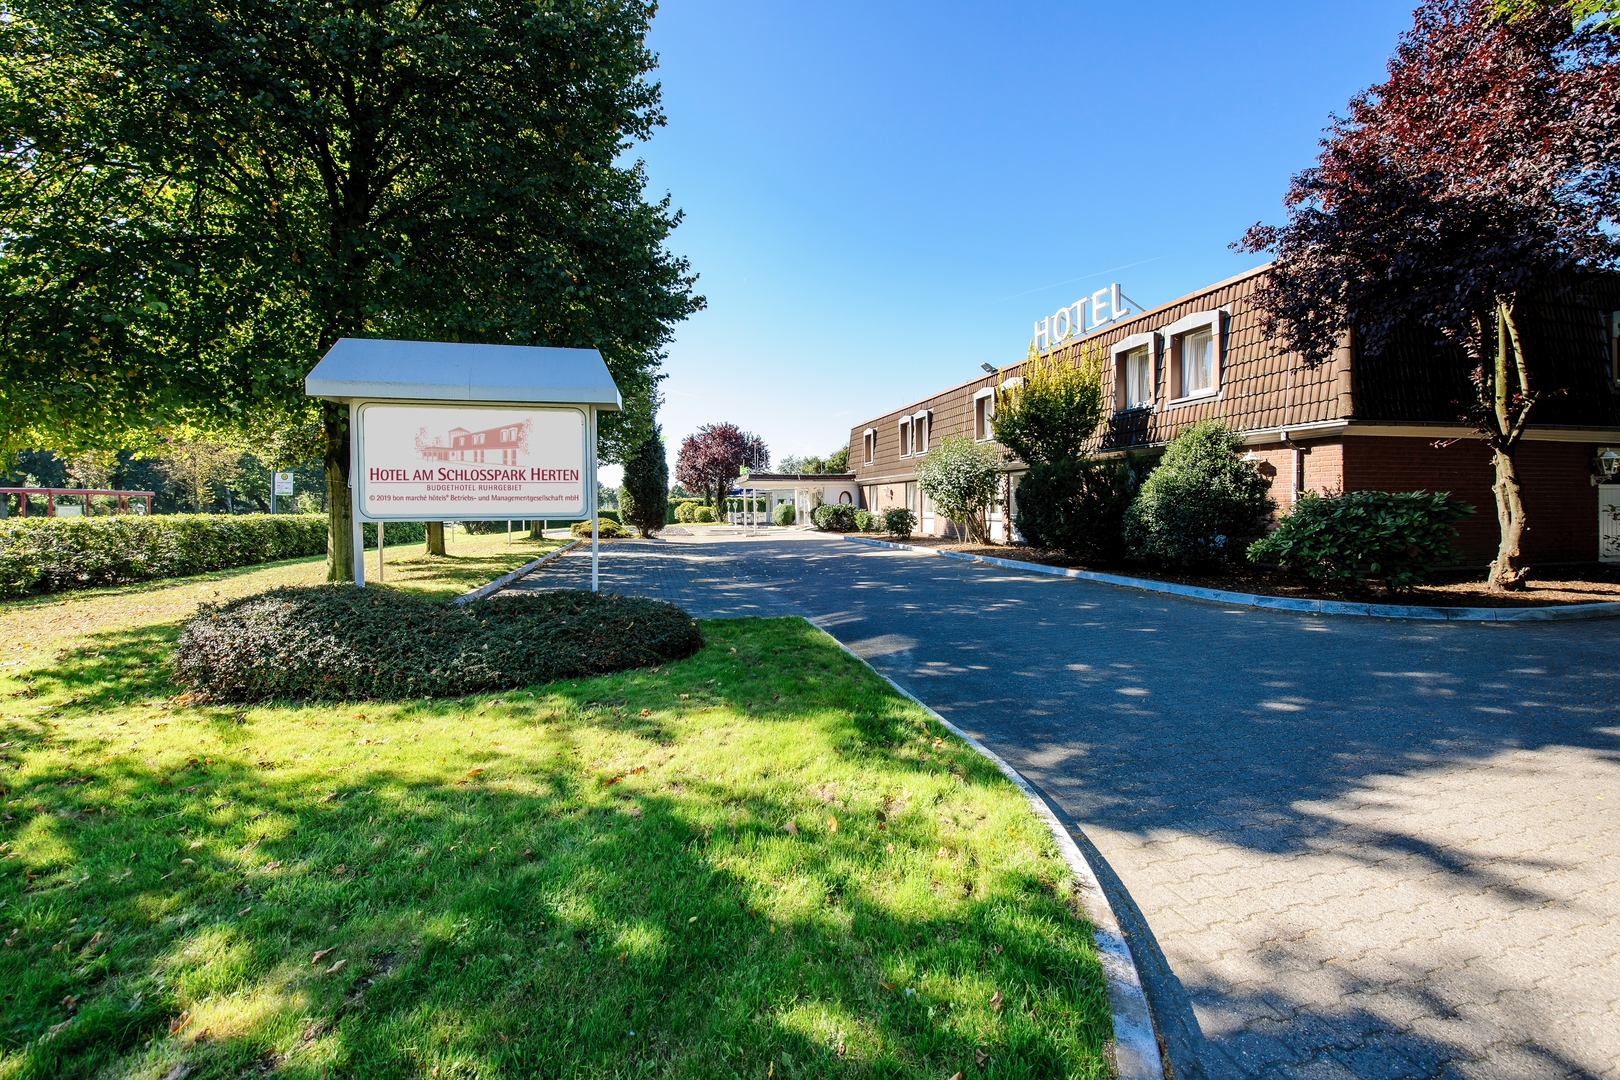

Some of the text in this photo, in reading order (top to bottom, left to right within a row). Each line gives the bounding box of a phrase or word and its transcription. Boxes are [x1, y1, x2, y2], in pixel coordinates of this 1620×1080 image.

[1034, 283, 1131, 350] HOTEL
[413, 470, 433, 481] AM
[427, 484, 522, 492] BUDGETHOTEL RUHRGEBIET
[491, 495, 564, 503] Managementgesellschaft
